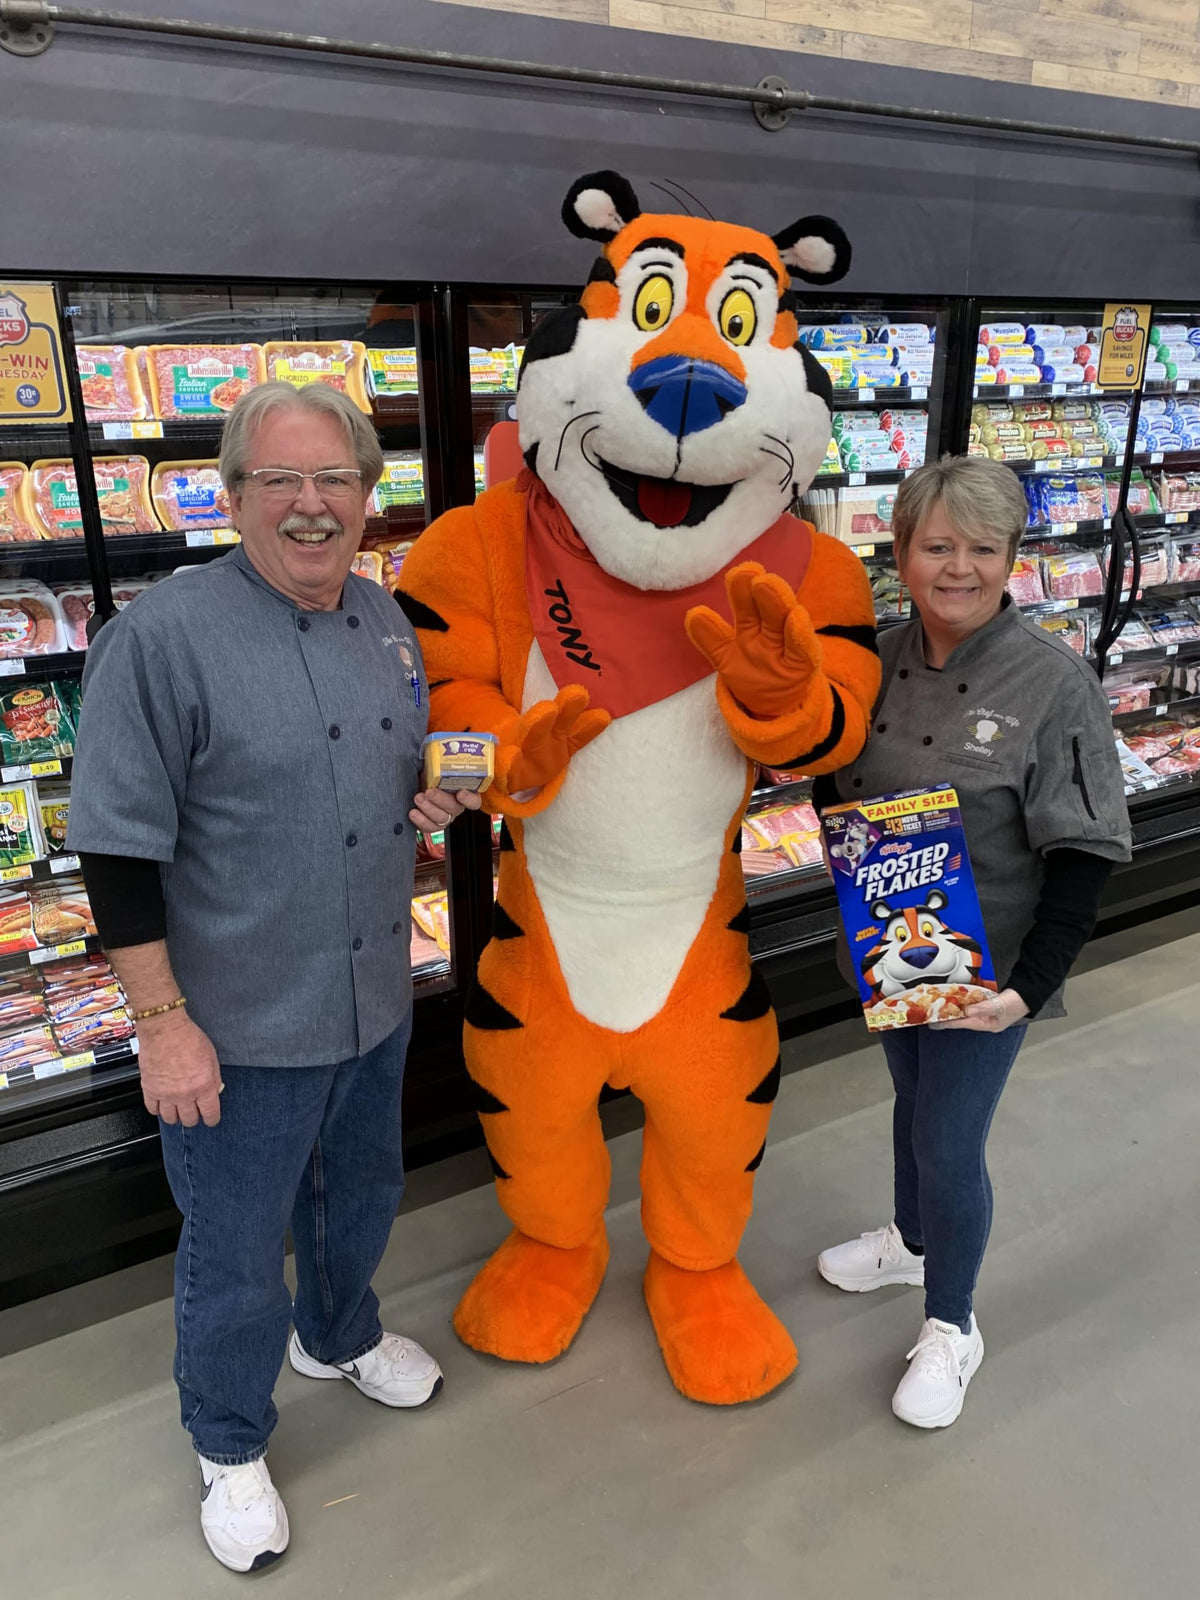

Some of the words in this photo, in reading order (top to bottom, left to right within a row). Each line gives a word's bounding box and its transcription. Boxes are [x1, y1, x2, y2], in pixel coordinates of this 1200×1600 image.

[189, 363, 232, 377] Johnsonville
[178, 377, 207, 387] Italian
[279, 374, 309, 383] CHORIZO
[544, 579, 601, 670] TONY
[963, 741, 994, 757] Shelley
[866, 801, 917, 818] FAMILY
[922, 793, 956, 807] SIZE
[855, 842, 950, 887] FROSTED
[2, 869, 19, 878] 4.99
[864, 861, 944, 902] FLAKES
